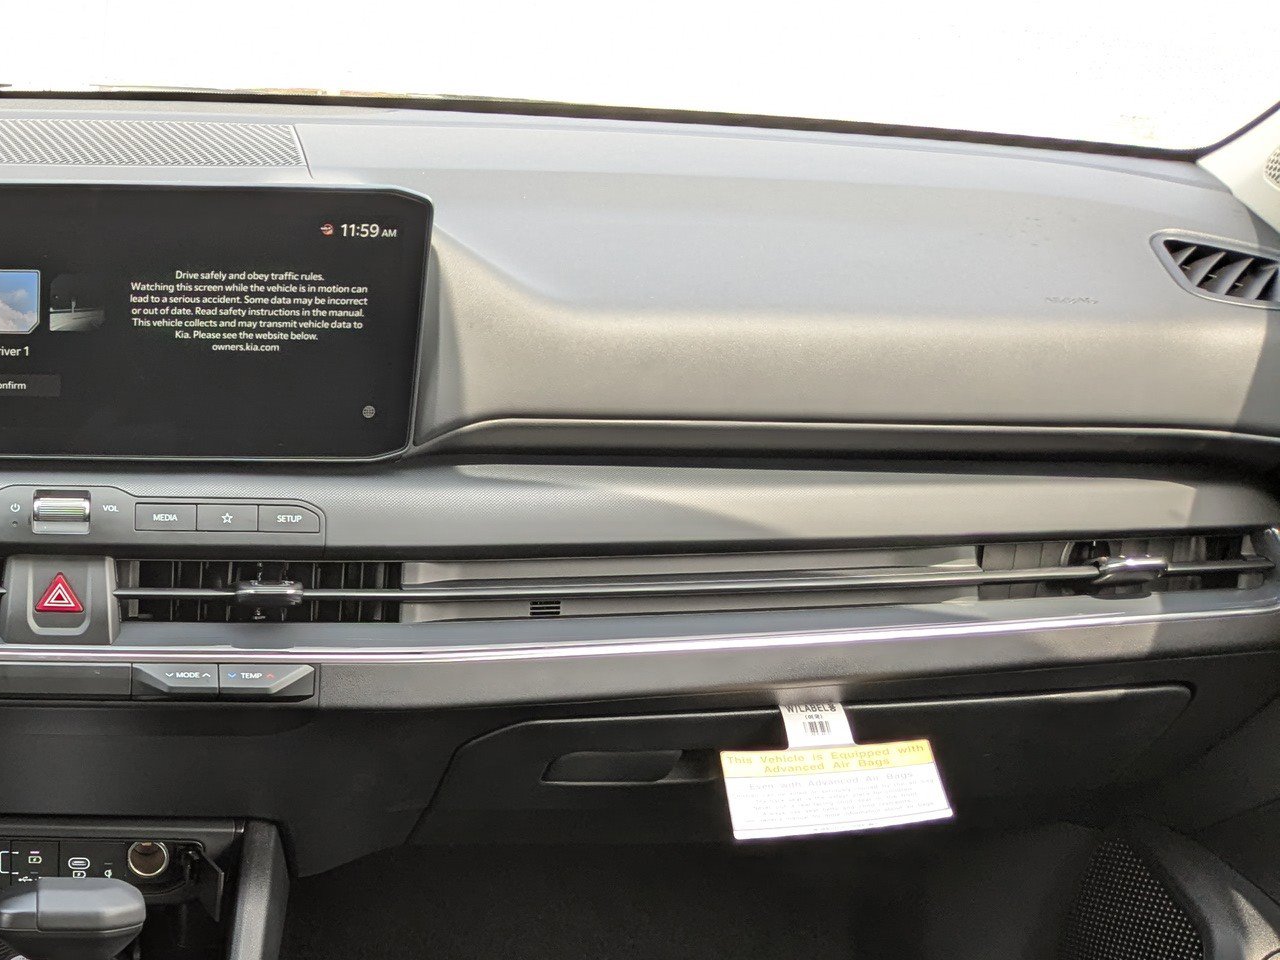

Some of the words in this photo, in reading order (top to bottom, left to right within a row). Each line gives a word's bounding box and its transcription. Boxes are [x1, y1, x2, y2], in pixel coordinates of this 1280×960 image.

[341, 223, 380, 238] 11:59
[381, 229, 397, 237] AM
[175, 270, 199, 280] Drive
[200, 271, 227, 281] safely
[228, 271, 246, 280] and
[247, 271, 270, 282] obey
[271, 272, 299, 280] traffic
[300, 272, 325, 281] rules.
[130, 282, 174, 293] Watching
[176, 283, 193, 291] this
[225, 283, 248, 292] while
[250, 284, 265, 292] the
[266, 284, 298, 292] vehicle
[299, 284, 306, 292] is
[307, 285, 316, 293] in
[317, 285, 349, 293] motion
[130, 294, 149, 303] lead
[169, 295, 200, 303] serious
[202, 295, 242, 304] accident.
[244, 295, 269, 304] Some
[270, 296, 290, 304] data
[293, 298, 313, 306] may
[314, 296, 326, 304] be
[327, 297, 368, 305] incorrect
[159, 306, 170, 315] of
[171, 307, 194, 315] date.
[195, 307, 218, 315] Read
[219, 307, 246, 317] safety
[248, 308, 300, 316] instructions
[302, 308, 310, 316] in
[312, 308, 327, 317] the
[329, 308, 364, 317] manual.
[132, 318, 151, 327] This
[152, 319, 183, 327] vehicle
[184, 319, 217, 327] collects
[219, 319, 236, 328] and
[238, 321, 257, 329] may
[259, 320, 297, 328] transmit
[299, 320, 330, 329] vehicle
[331, 320, 352, 329] data
[353, 321, 363, 329] to
[175, 330, 191, 339] Kia.
[193, 330, 221, 339] Please
[239, 331, 254, 339] the
[255, 332, 289, 340] website
[290, 332, 318, 340] below.
[23, 346, 29, 356] 1
[212, 343, 279, 351] owners.kia.com
[153, 513, 178, 521] MEDIA
[277, 514, 302, 523] SETUP
[727, 756, 753, 764] This
[760, 754, 805, 764] Vehicle
[831, 748, 890, 759] Equipped
[897, 745, 924, 754] with
[764, 763, 825, 773] Advanced
[833, 761, 850, 769] Air
[858, 758, 890, 767] Bags
